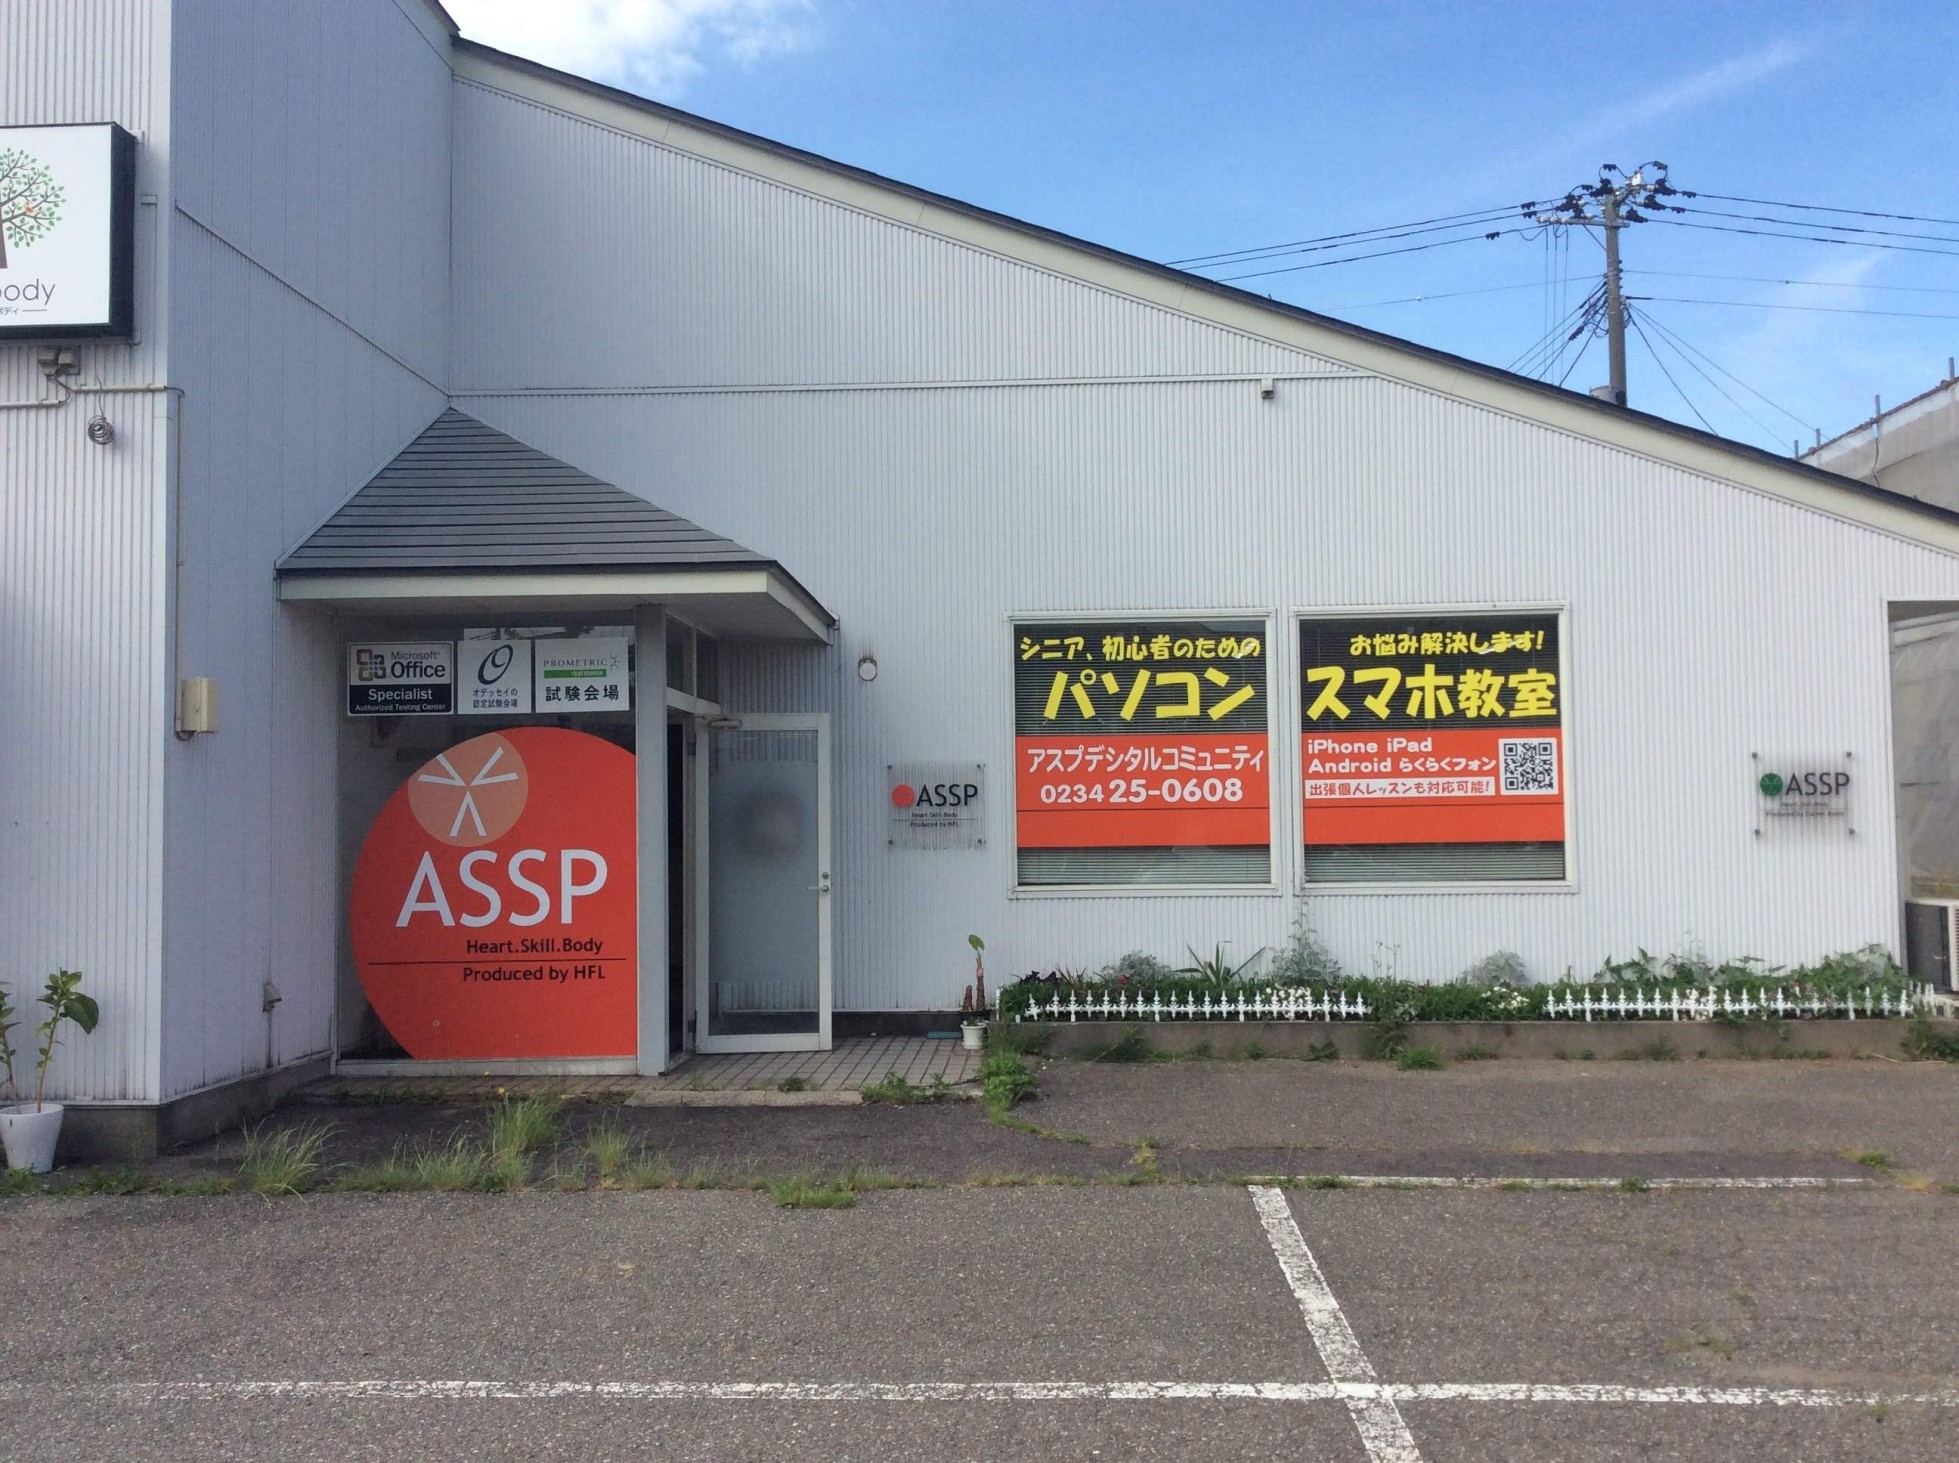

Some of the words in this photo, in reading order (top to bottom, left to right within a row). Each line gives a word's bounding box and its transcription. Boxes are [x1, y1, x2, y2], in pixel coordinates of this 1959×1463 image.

[0, 278, 56, 306] ody
[1020, 634, 1261, 662] シニア、初心者のための
[1349, 630, 1545, 657] お悩み解決します!
[391, 651, 438, 660] Microsoft
[543, 658, 608, 667] PROMETRIC
[390, 661, 446, 678] Office
[368, 688, 433, 702] Specialist
[473, 688, 518, 697] オデッセイの
[545, 684, 620, 702] 試験会場
[1043, 666, 1256, 722] パソコン
[1306, 663, 1558, 721] スマホ教室
[395, 704, 421, 712] Testing
[422, 703, 446, 711] Center
[1308, 739, 1378, 755] iPhone
[1386, 737, 1433, 753] iPad
[1308, 757, 1392, 775] Android
[1399, 756, 1497, 773] らくらくフォン
[1040, 783, 1105, 804] 0234
[1109, 777, 1244, 803] 25-0608
[1309, 781, 1491, 797] 出張個人レッスンも対応可能!
[1786, 772, 1850, 796] ASSP
[916, 784, 978, 807] ASSP
[395, 848, 608, 928] ASSP
[463, 966, 543, 982] Produced
[549, 965, 569, 983] by
[574, 965, 606, 980] HFL
